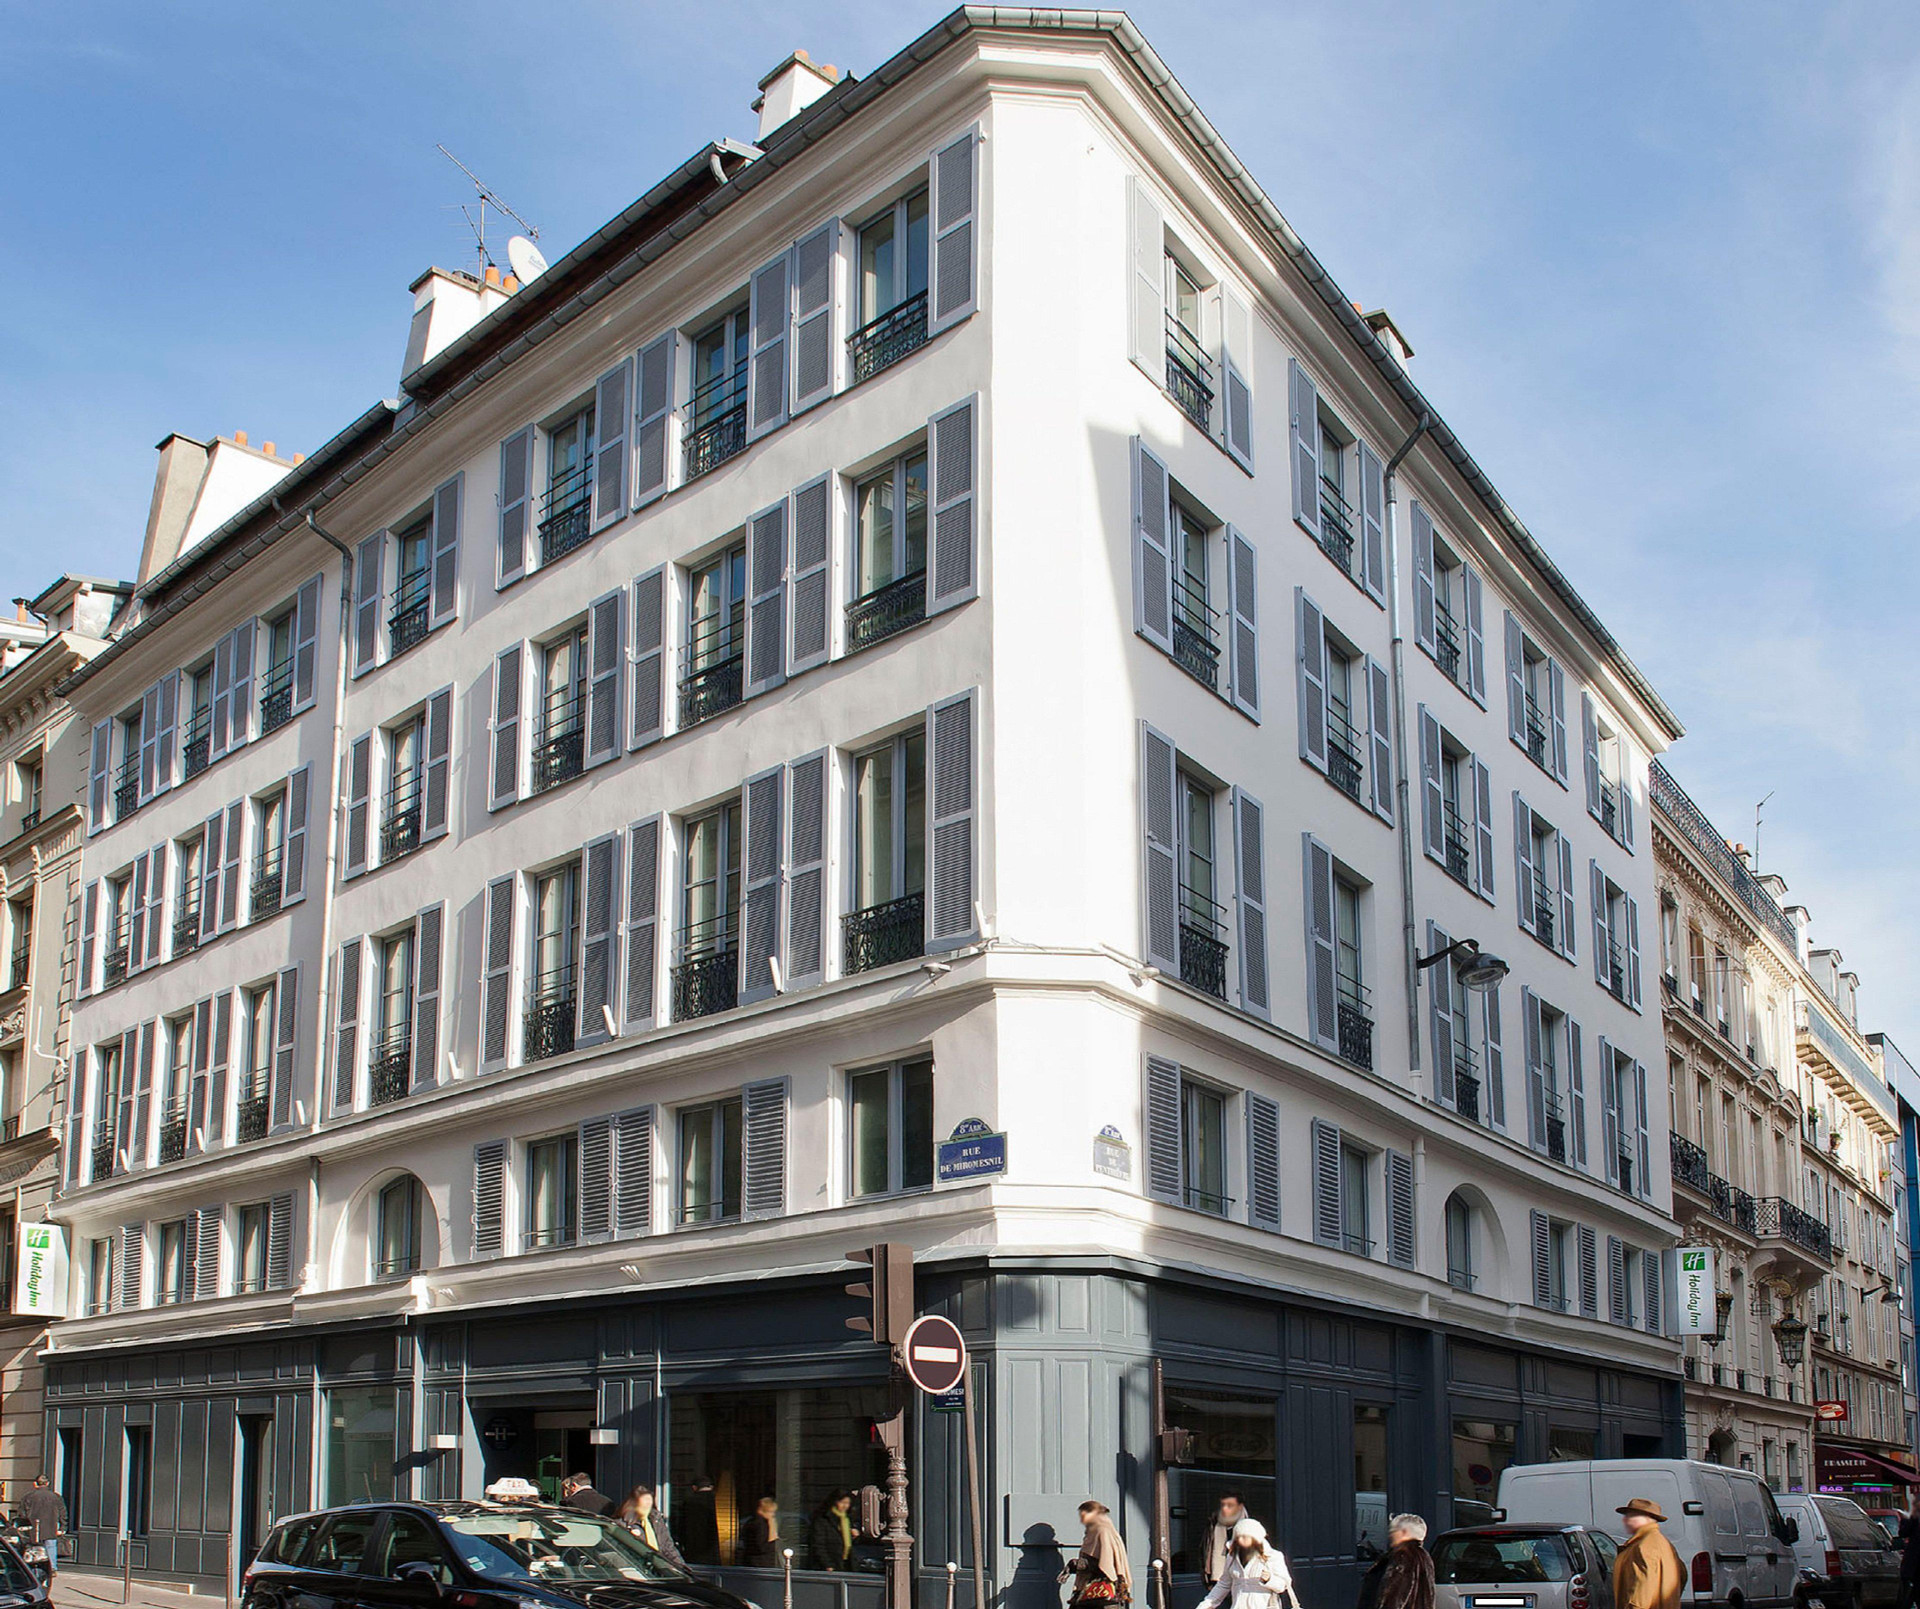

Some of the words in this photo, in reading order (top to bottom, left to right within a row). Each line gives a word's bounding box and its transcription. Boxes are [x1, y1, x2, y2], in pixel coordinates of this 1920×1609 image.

[962, 1147, 981, 1156] RUE
[940, 1165, 952, 1173] DE
[953, 1157, 1004, 1171] MIROMESNIL
[27, 1251, 43, 1291] Holiday
[29, 1290, 42, 1307] Inn
[1687, 1274, 1701, 1311] Holiday
[1690, 1312, 1702, 1328] Inn
[1819, 1484, 1844, 1493] BAR
